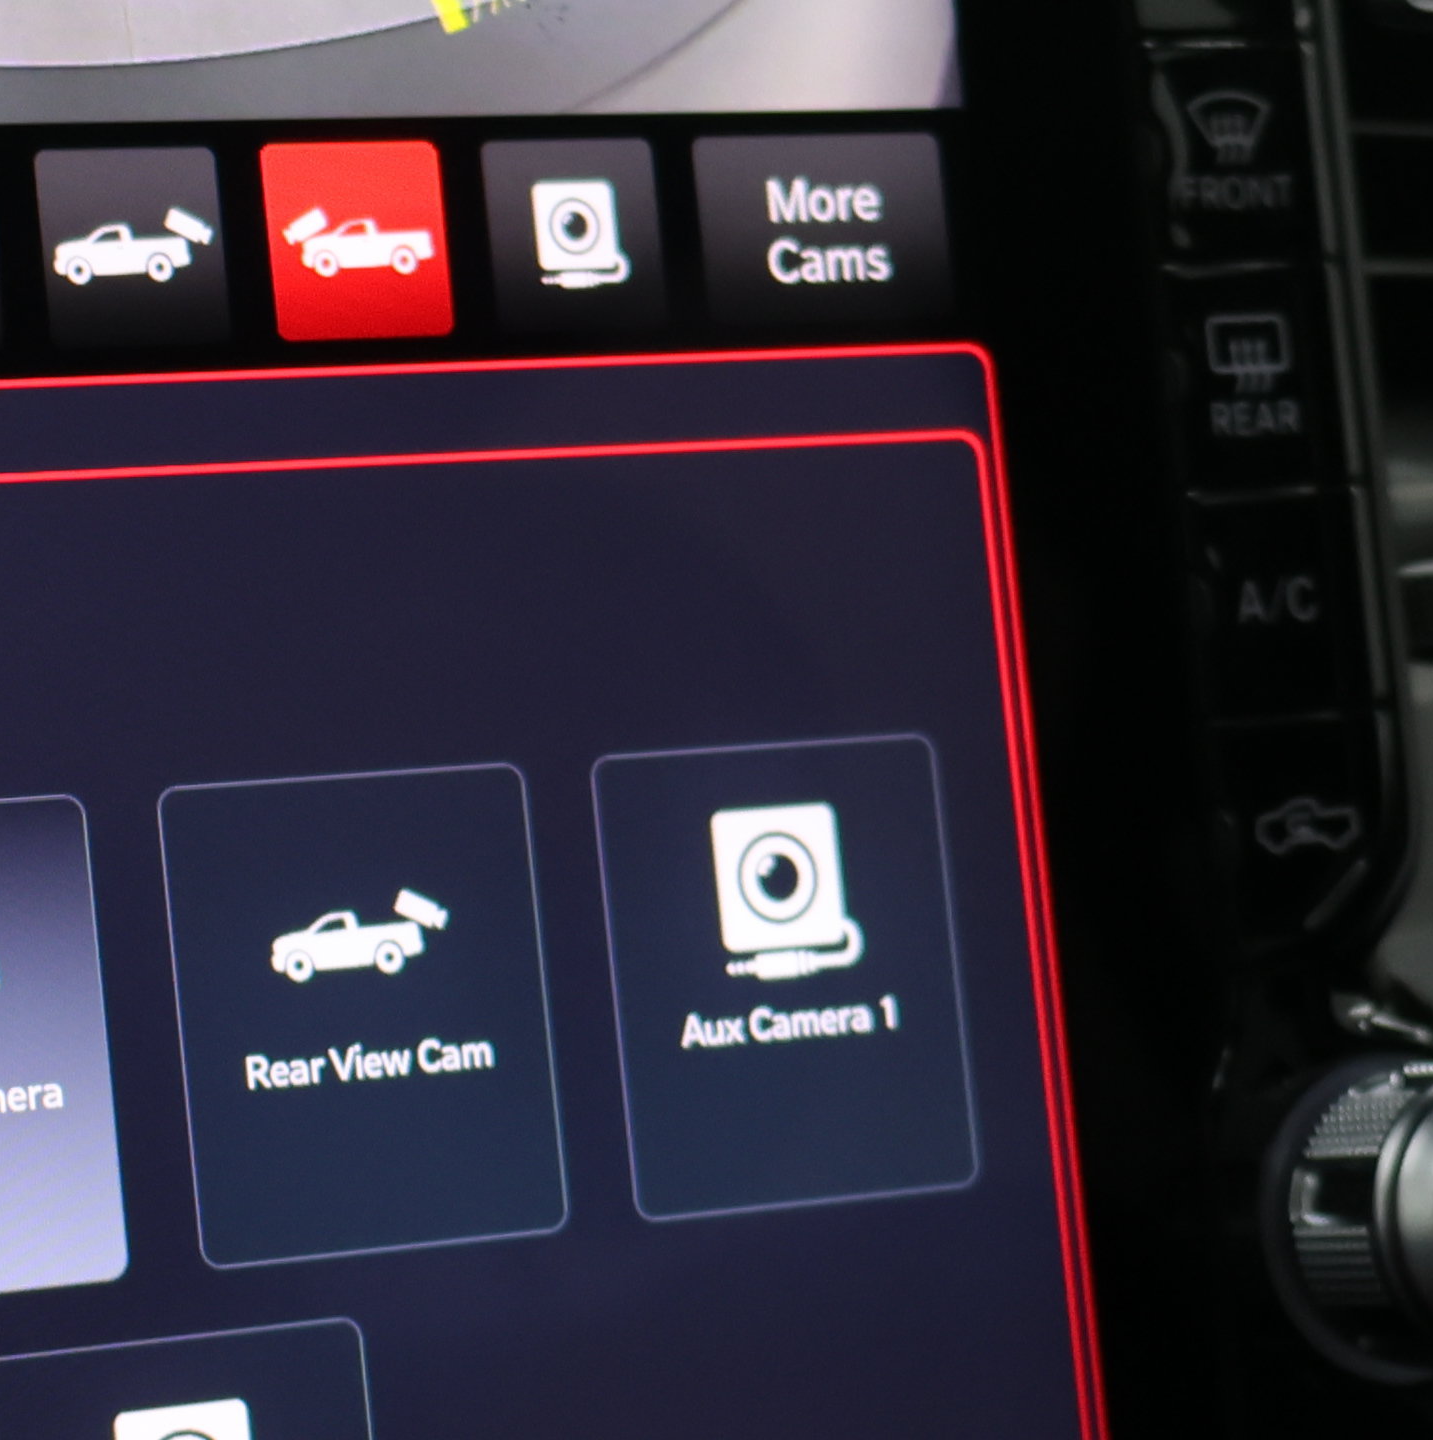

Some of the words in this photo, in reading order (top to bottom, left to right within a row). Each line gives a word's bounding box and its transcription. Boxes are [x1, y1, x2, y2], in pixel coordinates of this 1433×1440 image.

[765, 177, 882, 223] More
[1180, 174, 1293, 210] FRONT
[767, 237, 893, 284] Cams
[1211, 399, 1300, 436] REAR
[1239, 575, 1317, 622] A/C
[681, 1012, 748, 1049] Aux
[748, 1004, 866, 1043] Camera
[871, 994, 899, 1031] 1
[245, 1053, 326, 1091] Rear
[327, 1042, 413, 1082] View
[417, 1037, 495, 1074] Cam
